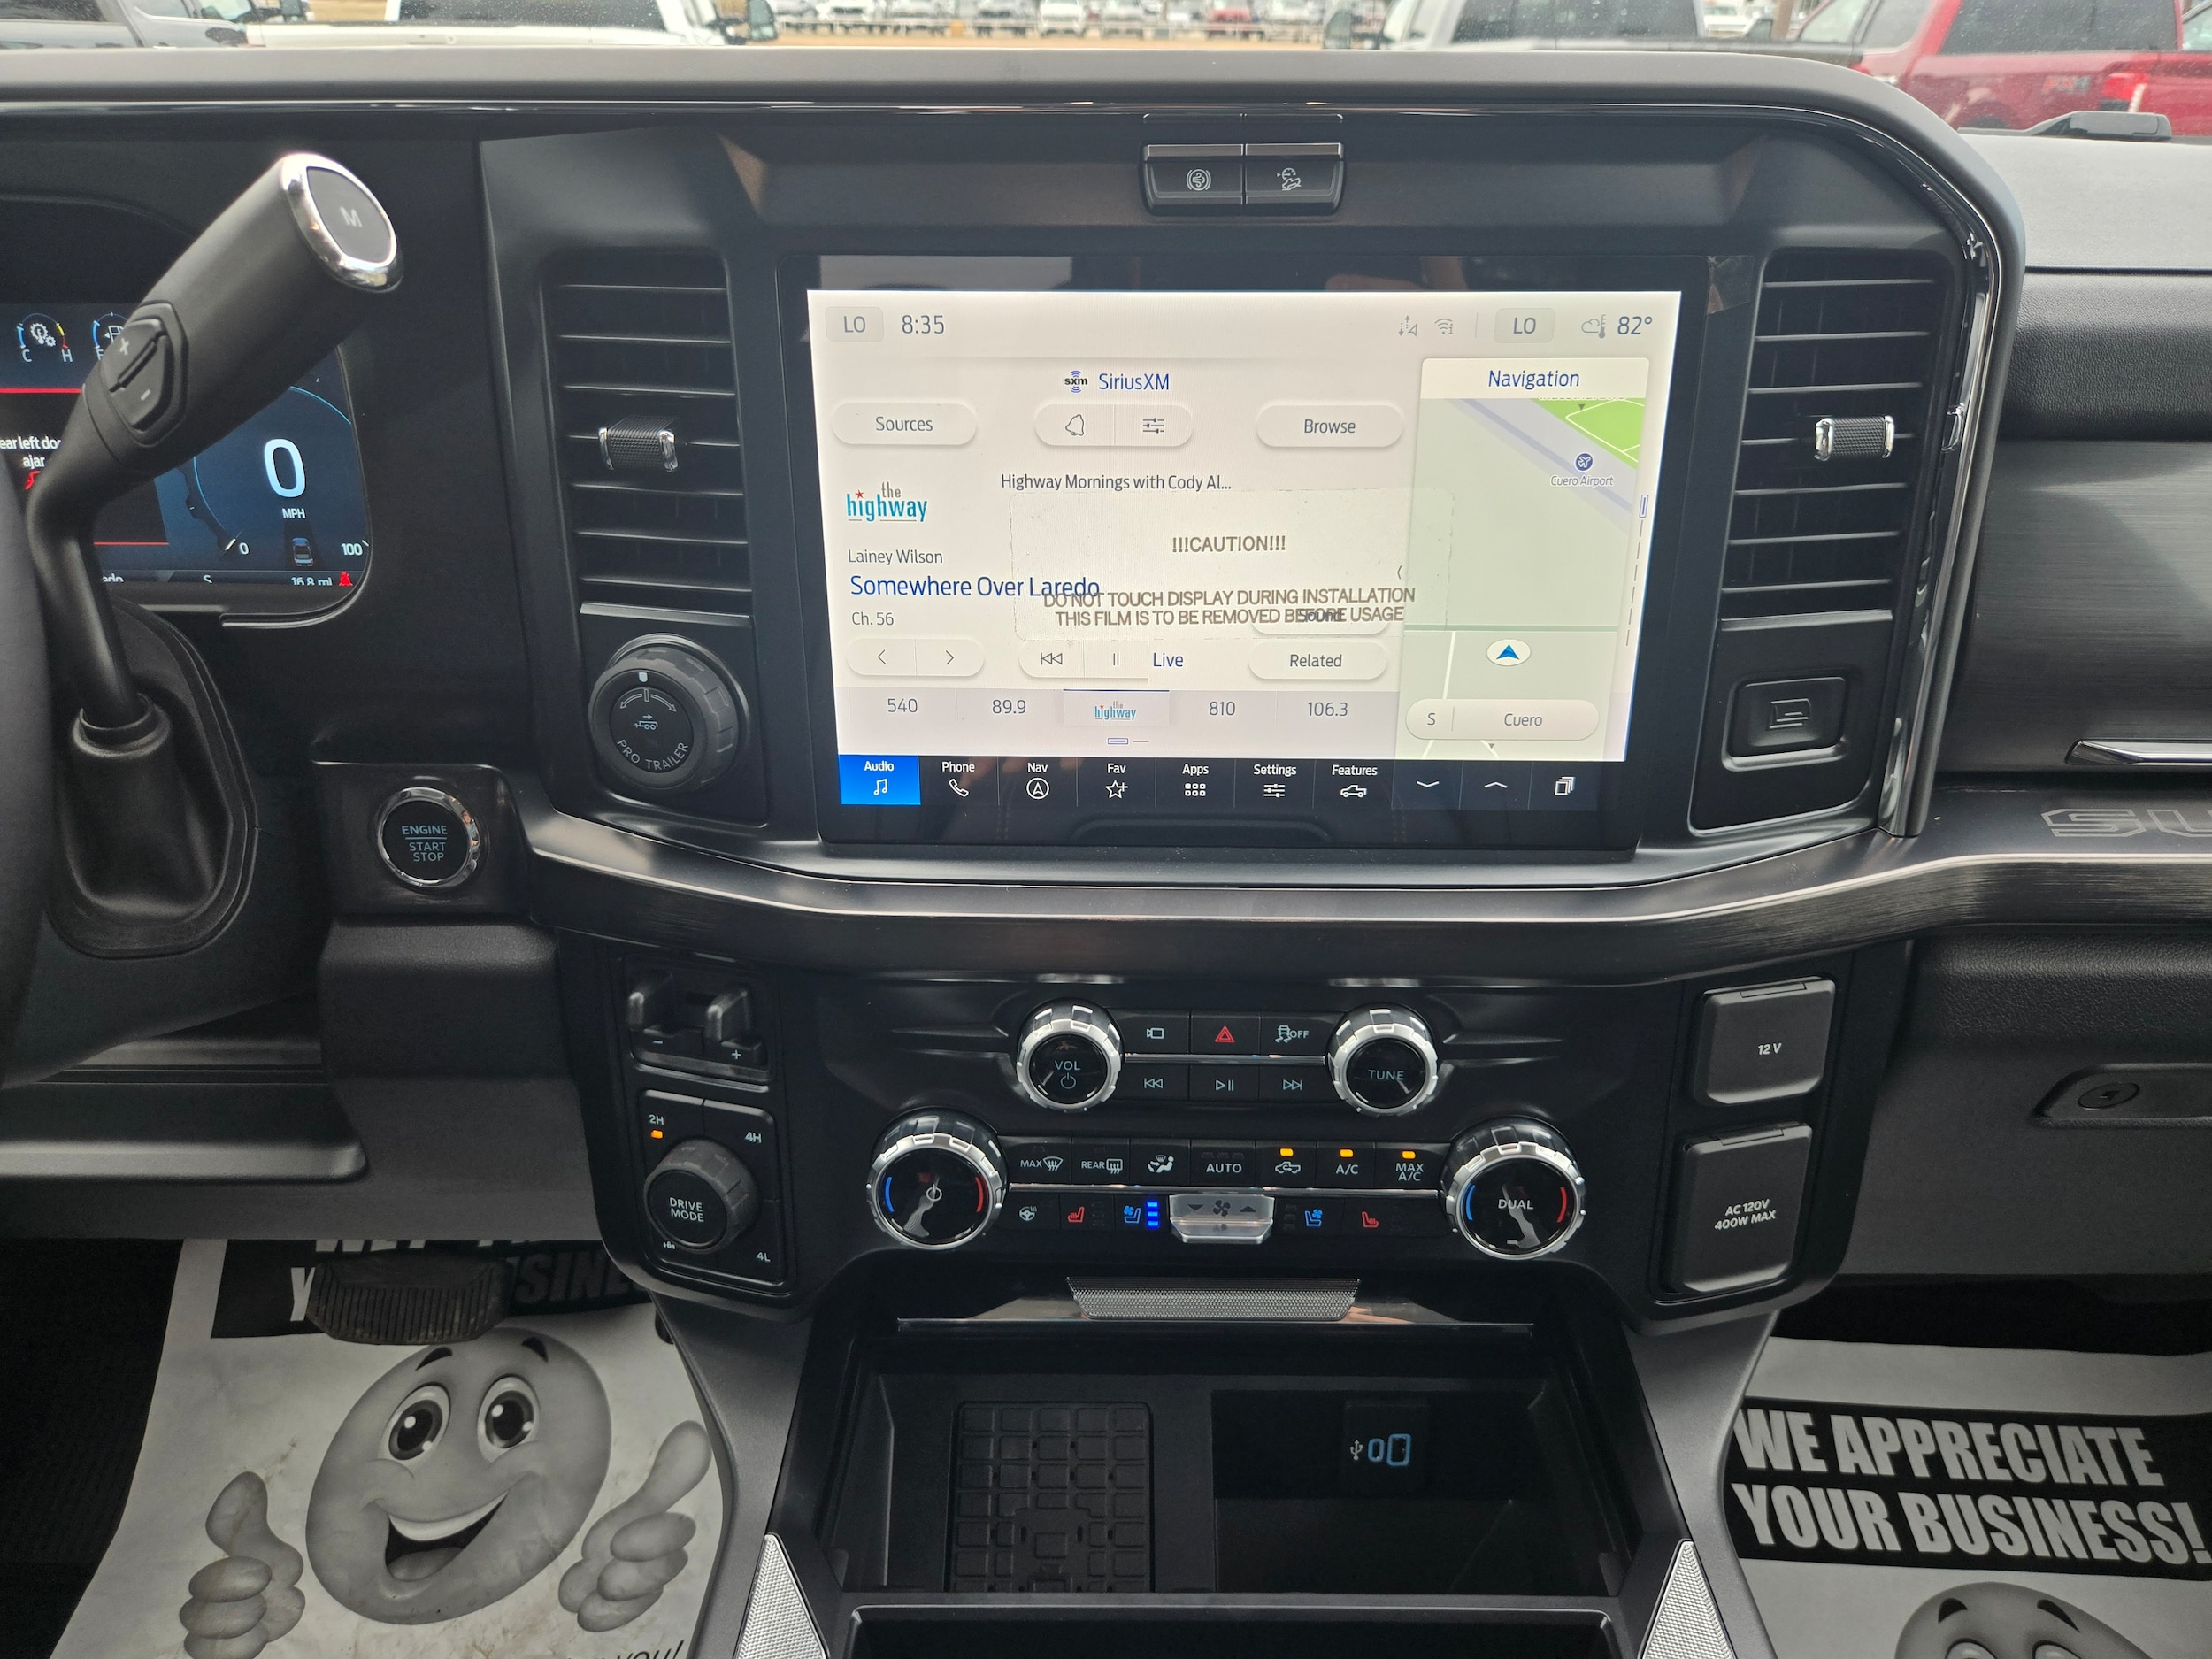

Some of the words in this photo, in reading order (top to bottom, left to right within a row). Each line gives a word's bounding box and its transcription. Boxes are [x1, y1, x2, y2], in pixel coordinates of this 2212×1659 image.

[341, 208, 362, 227] M
[842, 315, 866, 334] LO
[901, 314, 945, 335] 8:35
[1512, 316, 1536, 334] LO
[1617, 316, 1653, 336] 82°
[22, 349, 33, 363] C
[61, 349, 73, 363] H
[1064, 376, 1088, 388] sxm
[1098, 373, 1171, 391] SiriusXM
[1487, 370, 1581, 391] Navigation
[875, 416, 933, 433] Sources
[1303, 419, 1356, 434] Browse
[0, 439, 18, 449] ear
[18, 435, 41, 449] left
[22, 454, 46, 469] ajar
[265, 438, 306, 497] 0
[1001, 473, 1063, 491] Highway
[1065, 473, 1131, 492] Mornings
[1133, 474, 1164, 489] with
[1168, 475, 1203, 492] Cody
[1550, 474, 1578, 487] Cuero
[1581, 474, 1614, 489] Airport
[881, 481, 902, 498] the
[282, 509, 305, 519] MPH
[847, 493, 928, 523] highway
[239, 542, 250, 555] 0
[341, 542, 363, 556] 100
[1171, 535, 1286, 553] !!!CAUTION!!!
[848, 549, 893, 566] Lainey
[896, 549, 943, 564] Wilson
[850, 575, 972, 596] Somewhere
[977, 577, 1024, 597] Over
[1029, 577, 1100, 597] Laredo
[1071, 591, 1103, 608] NOT
[1108, 591, 1164, 607] TOUCH
[1167, 591, 1233, 607] DISPLAY
[1237, 589, 1299, 605] DURING
[1302, 588, 1416, 604] INSTALLATION
[851, 611, 873, 626] Ch.
[876, 613, 894, 626] 56
[1056, 611, 1091, 626] THIS
[1094, 611, 1132, 626] FILM
[1135, 611, 1150, 626] IS
[1152, 611, 1175, 626] TO
[1178, 610, 1199, 625] BE
[1202, 609, 1280, 625] REMOVED
[1284, 608, 1347, 624] BEFORE
[1350, 607, 1404, 622] USAGE
[1153, 653, 1184, 668] Live
[1289, 654, 1342, 668] Related
[887, 698, 918, 714] 540
[992, 700, 1026, 715] 89.9
[1094, 705, 1137, 720] highway
[1209, 702, 1236, 716] 810
[1307, 702, 1348, 717] 106.3
[1427, 713, 1436, 726] S
[1503, 713, 1543, 727] Cuero
[617, 739, 641, 764] PRO
[645, 742, 688, 771] TRAILER
[864, 761, 895, 772] Audio
[941, 761, 975, 773] Phone
[1027, 763, 1048, 773] Nav
[1107, 763, 1126, 775] Fav
[1182, 764, 1209, 777] Apps
[1253, 764, 1297, 779] Settings
[1332, 764, 1378, 777] Features
[402, 825, 448, 835] ENGINE
[409, 841, 446, 851] START
[412, 852, 444, 862] STOP
[1290, 1029, 1309, 1040] OFF
[1757, 1044, 1770, 1055] 12
[1771, 1042, 1782, 1053] V
[1054, 1061, 1080, 1071] VOL
[1368, 1070, 1404, 1081] TUNE
[649, 1114, 664, 1125] 2H
[745, 1132, 762, 1143] 4H
[1020, 1159, 1042, 1168] MAX
[1081, 1160, 1105, 1169] REAR
[1206, 1163, 1242, 1173] AUTO
[1335, 1164, 1359, 1175] A/C
[1395, 1163, 1425, 1172] MAX
[1398, 1172, 1421, 1182] A/C
[669, 1197, 703, 1212] DRIVE
[1498, 1199, 1534, 1210] DUAL
[1724, 1204, 1741, 1216] AC
[1742, 1199, 1770, 1213] 120V
[671, 1208, 704, 1223] MODE
[1714, 1217, 1749, 1231] 400W
[1750, 1210, 1777, 1224] MAX
[757, 1252, 771, 1263] 4L
[1733, 1408, 1828, 1472] WE
[1828, 1413, 2165, 1486] APPRECIATE
[1731, 1482, 1901, 1552] YOUR
[1897, 1491, 2212, 1565] BUSINESS!
